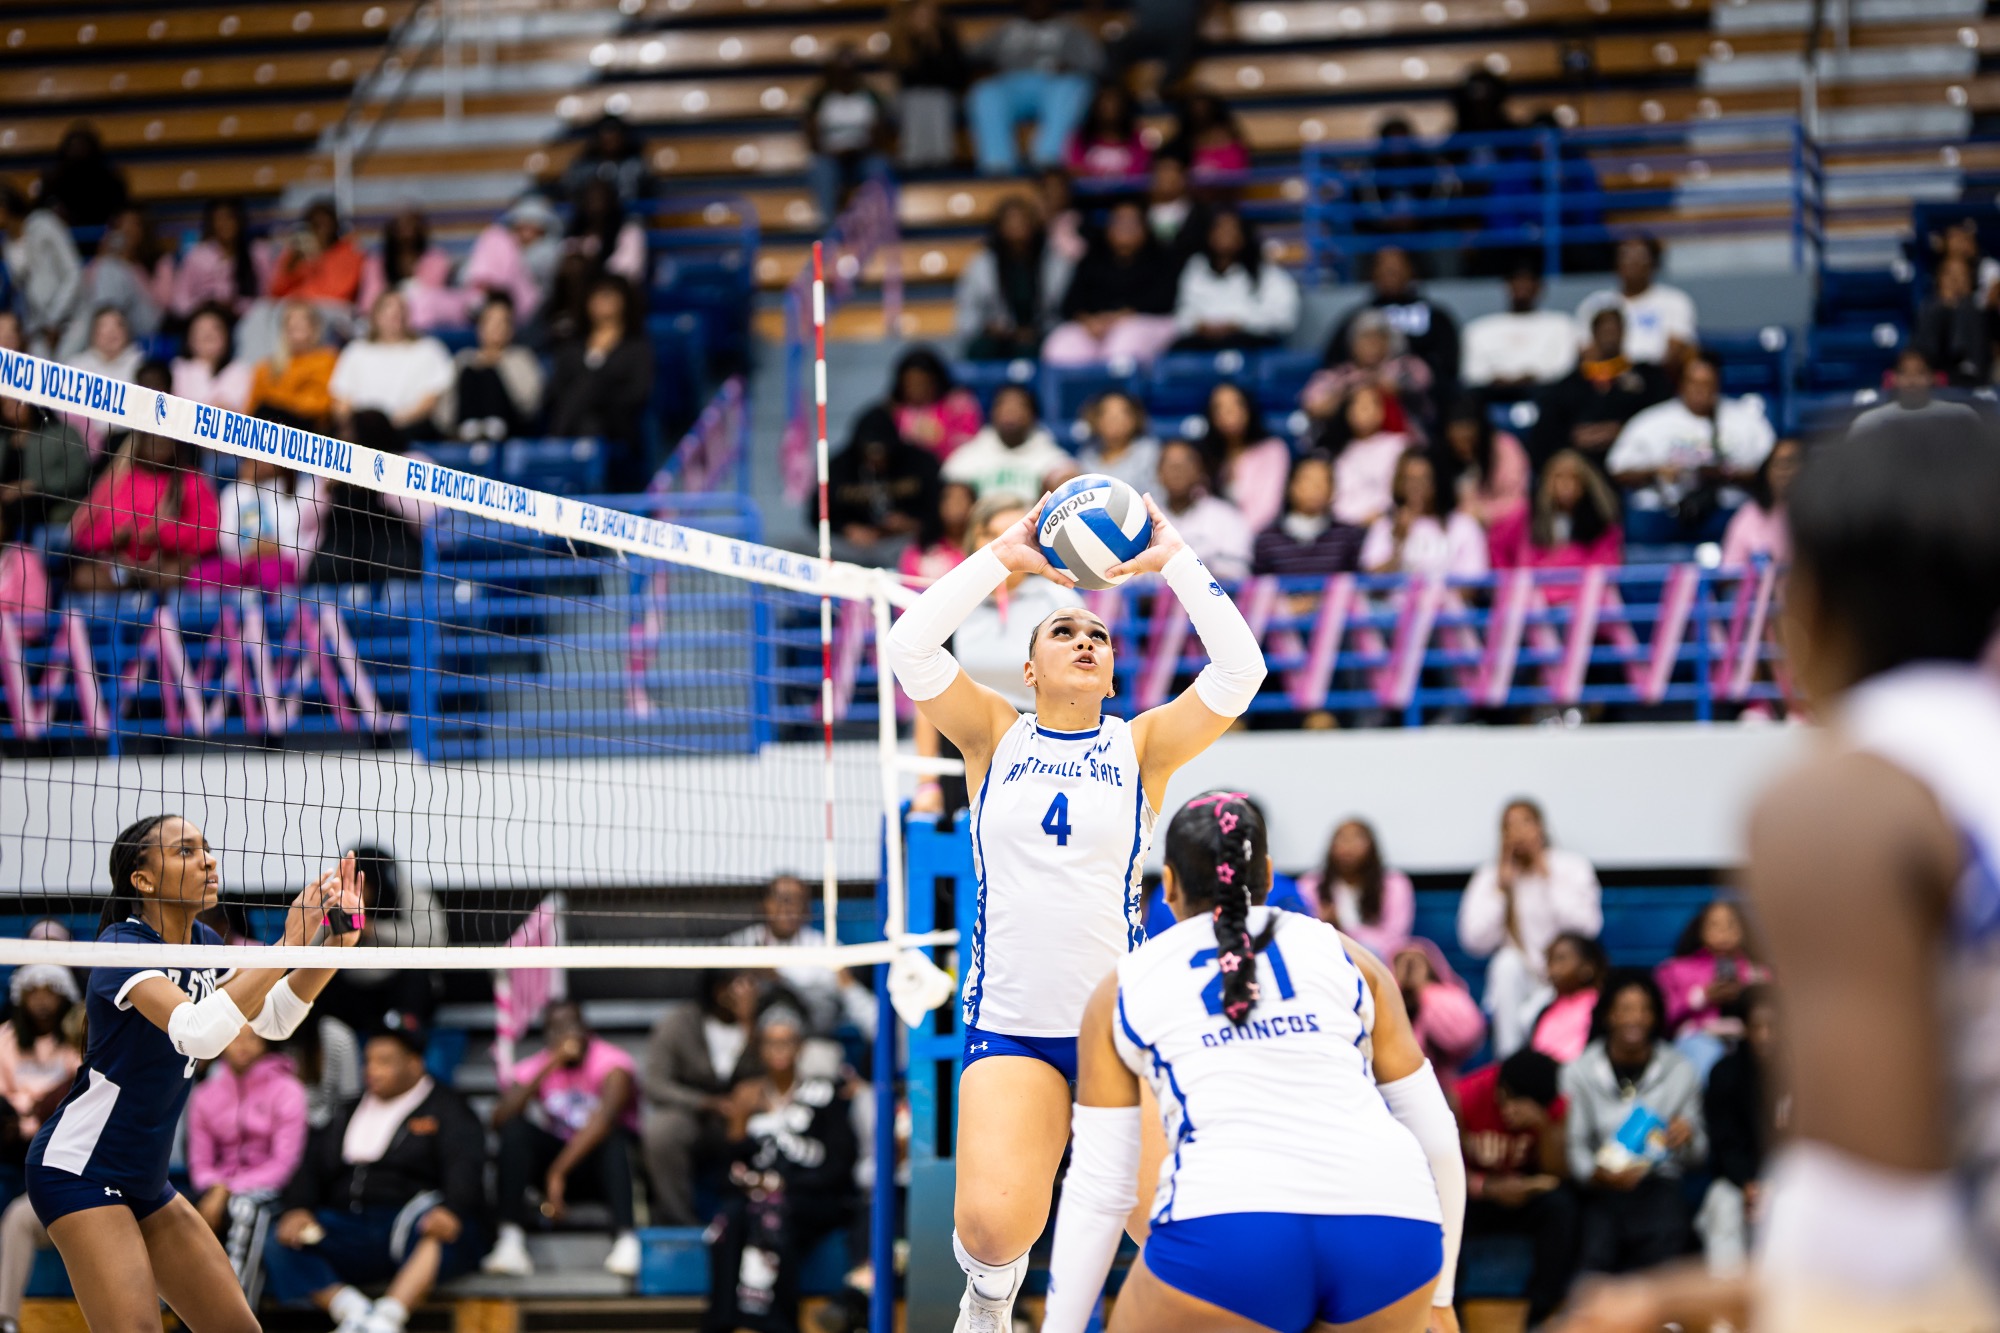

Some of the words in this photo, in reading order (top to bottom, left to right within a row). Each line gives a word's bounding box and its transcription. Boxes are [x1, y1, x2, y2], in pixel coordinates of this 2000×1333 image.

[0, 351, 34, 391] NCO
[40, 363, 126, 416] VOLLEYBALL
[194, 404, 221, 439] FSU
[222, 412, 279, 455] BRONCO
[281, 427, 352, 473] VOLLEYBALL
[406, 461, 429, 491] FSU
[1044, 491, 1096, 535] molten
[1041, 791, 1072, 846] 4
